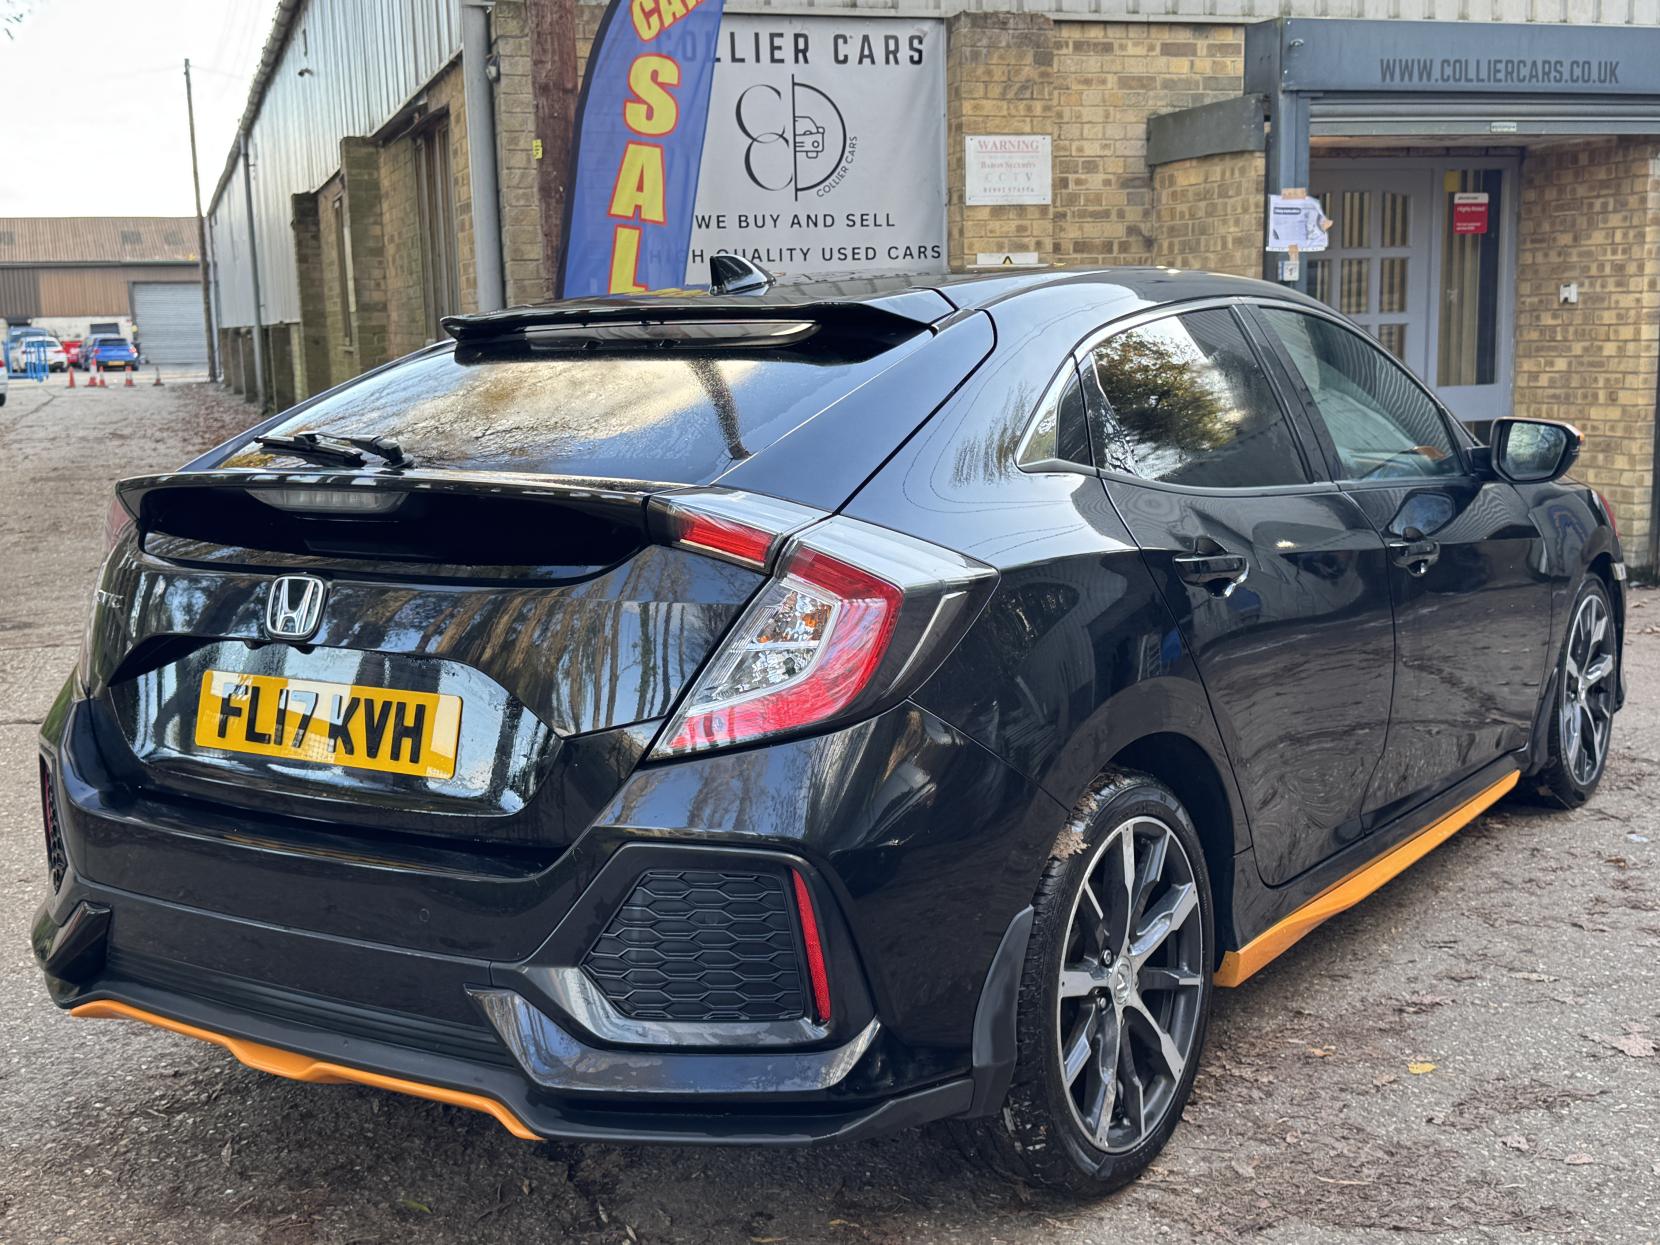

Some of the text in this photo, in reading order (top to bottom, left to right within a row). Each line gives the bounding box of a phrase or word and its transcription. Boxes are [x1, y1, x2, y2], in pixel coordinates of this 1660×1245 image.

[630, 0, 704, 42] CA
[833, 33, 923, 65] CARS
[1380, 58, 1620, 84] WWW.COLLIERCARS.CO.UK
[977, 139, 1040, 151] WARNING
[607, 52, 682, 295] SAL
[816, 136, 857, 197] COLLIER CARS
[695, 212, 896, 229] WE BUY AND SELL
[821, 246, 877, 261] USED
[887, 244, 941, 260] CARS
[217, 682, 427, 764] FL17 KVH
